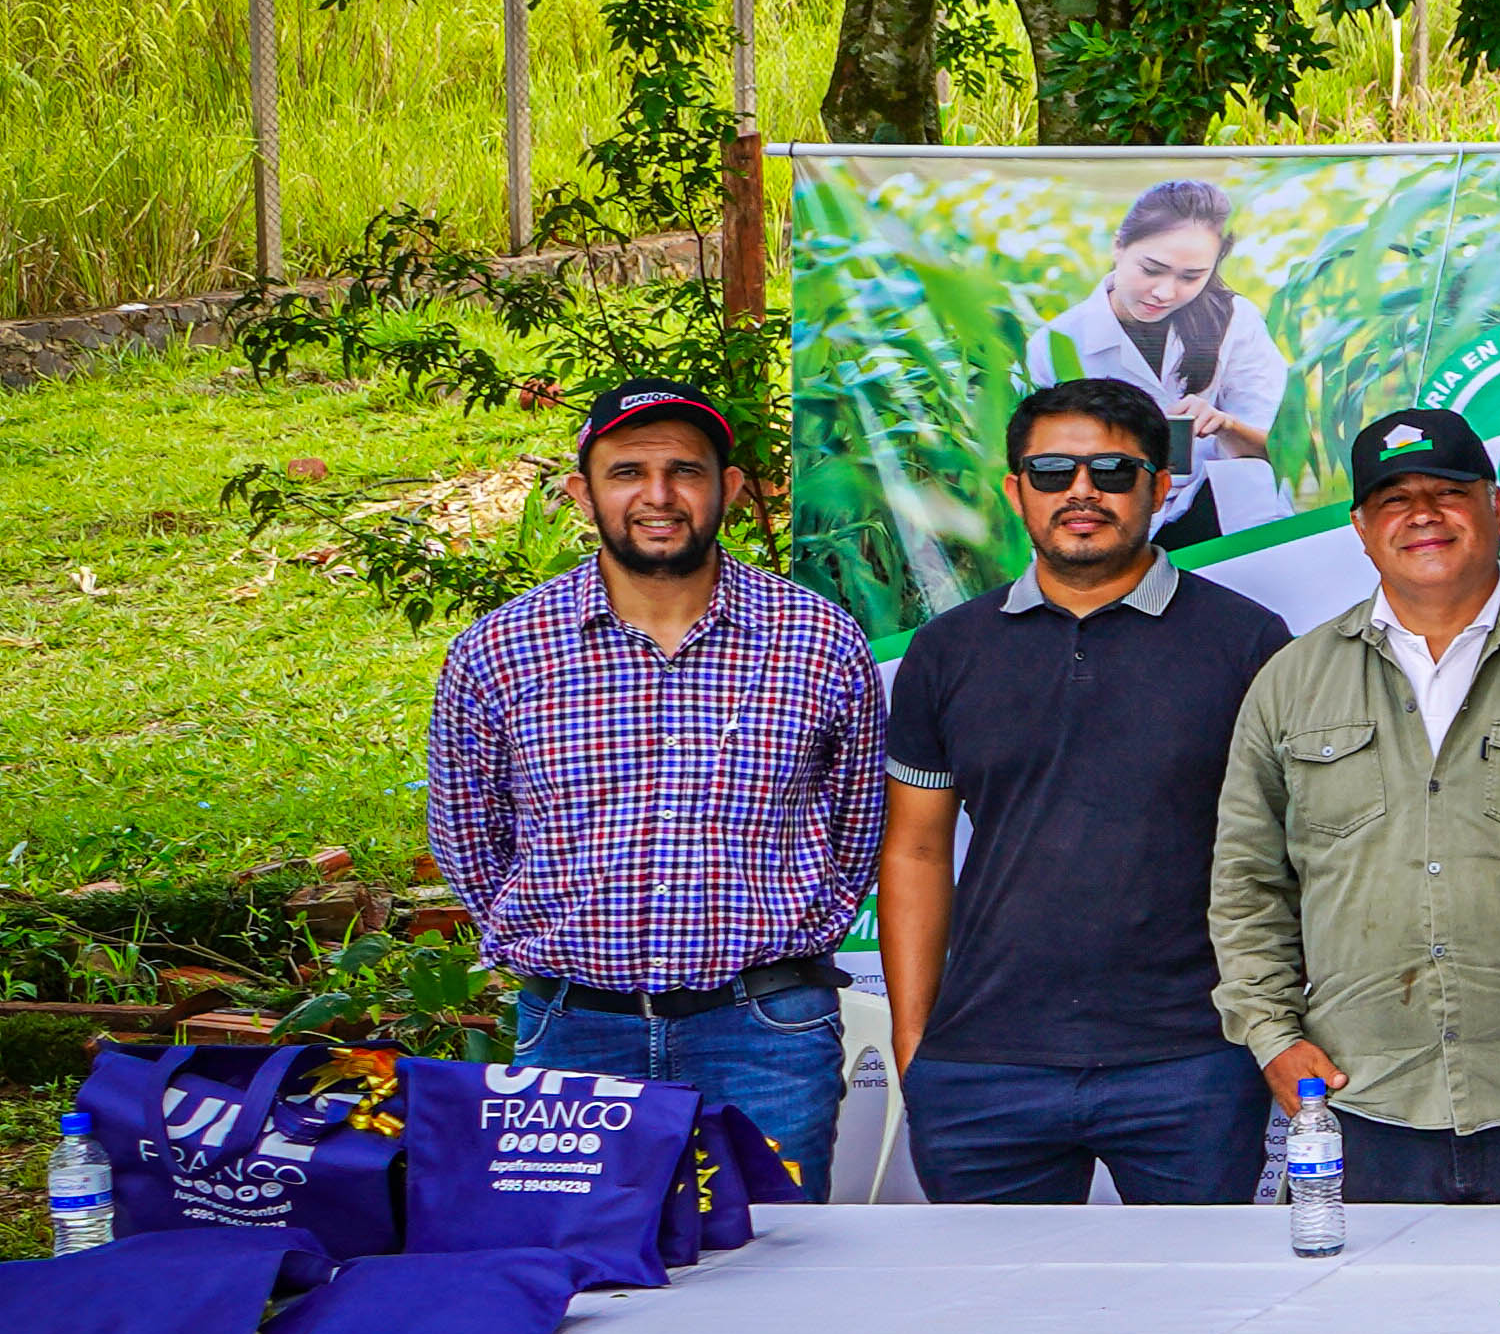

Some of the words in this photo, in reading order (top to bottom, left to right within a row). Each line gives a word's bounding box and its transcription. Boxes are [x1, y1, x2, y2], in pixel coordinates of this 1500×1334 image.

[1462, 340, 1498, 371] EN
[481, 1099, 633, 1131] FRANCO
[488, 1159, 603, 1175] /upefrancocentral
[492, 1179, 523, 1192] +595
